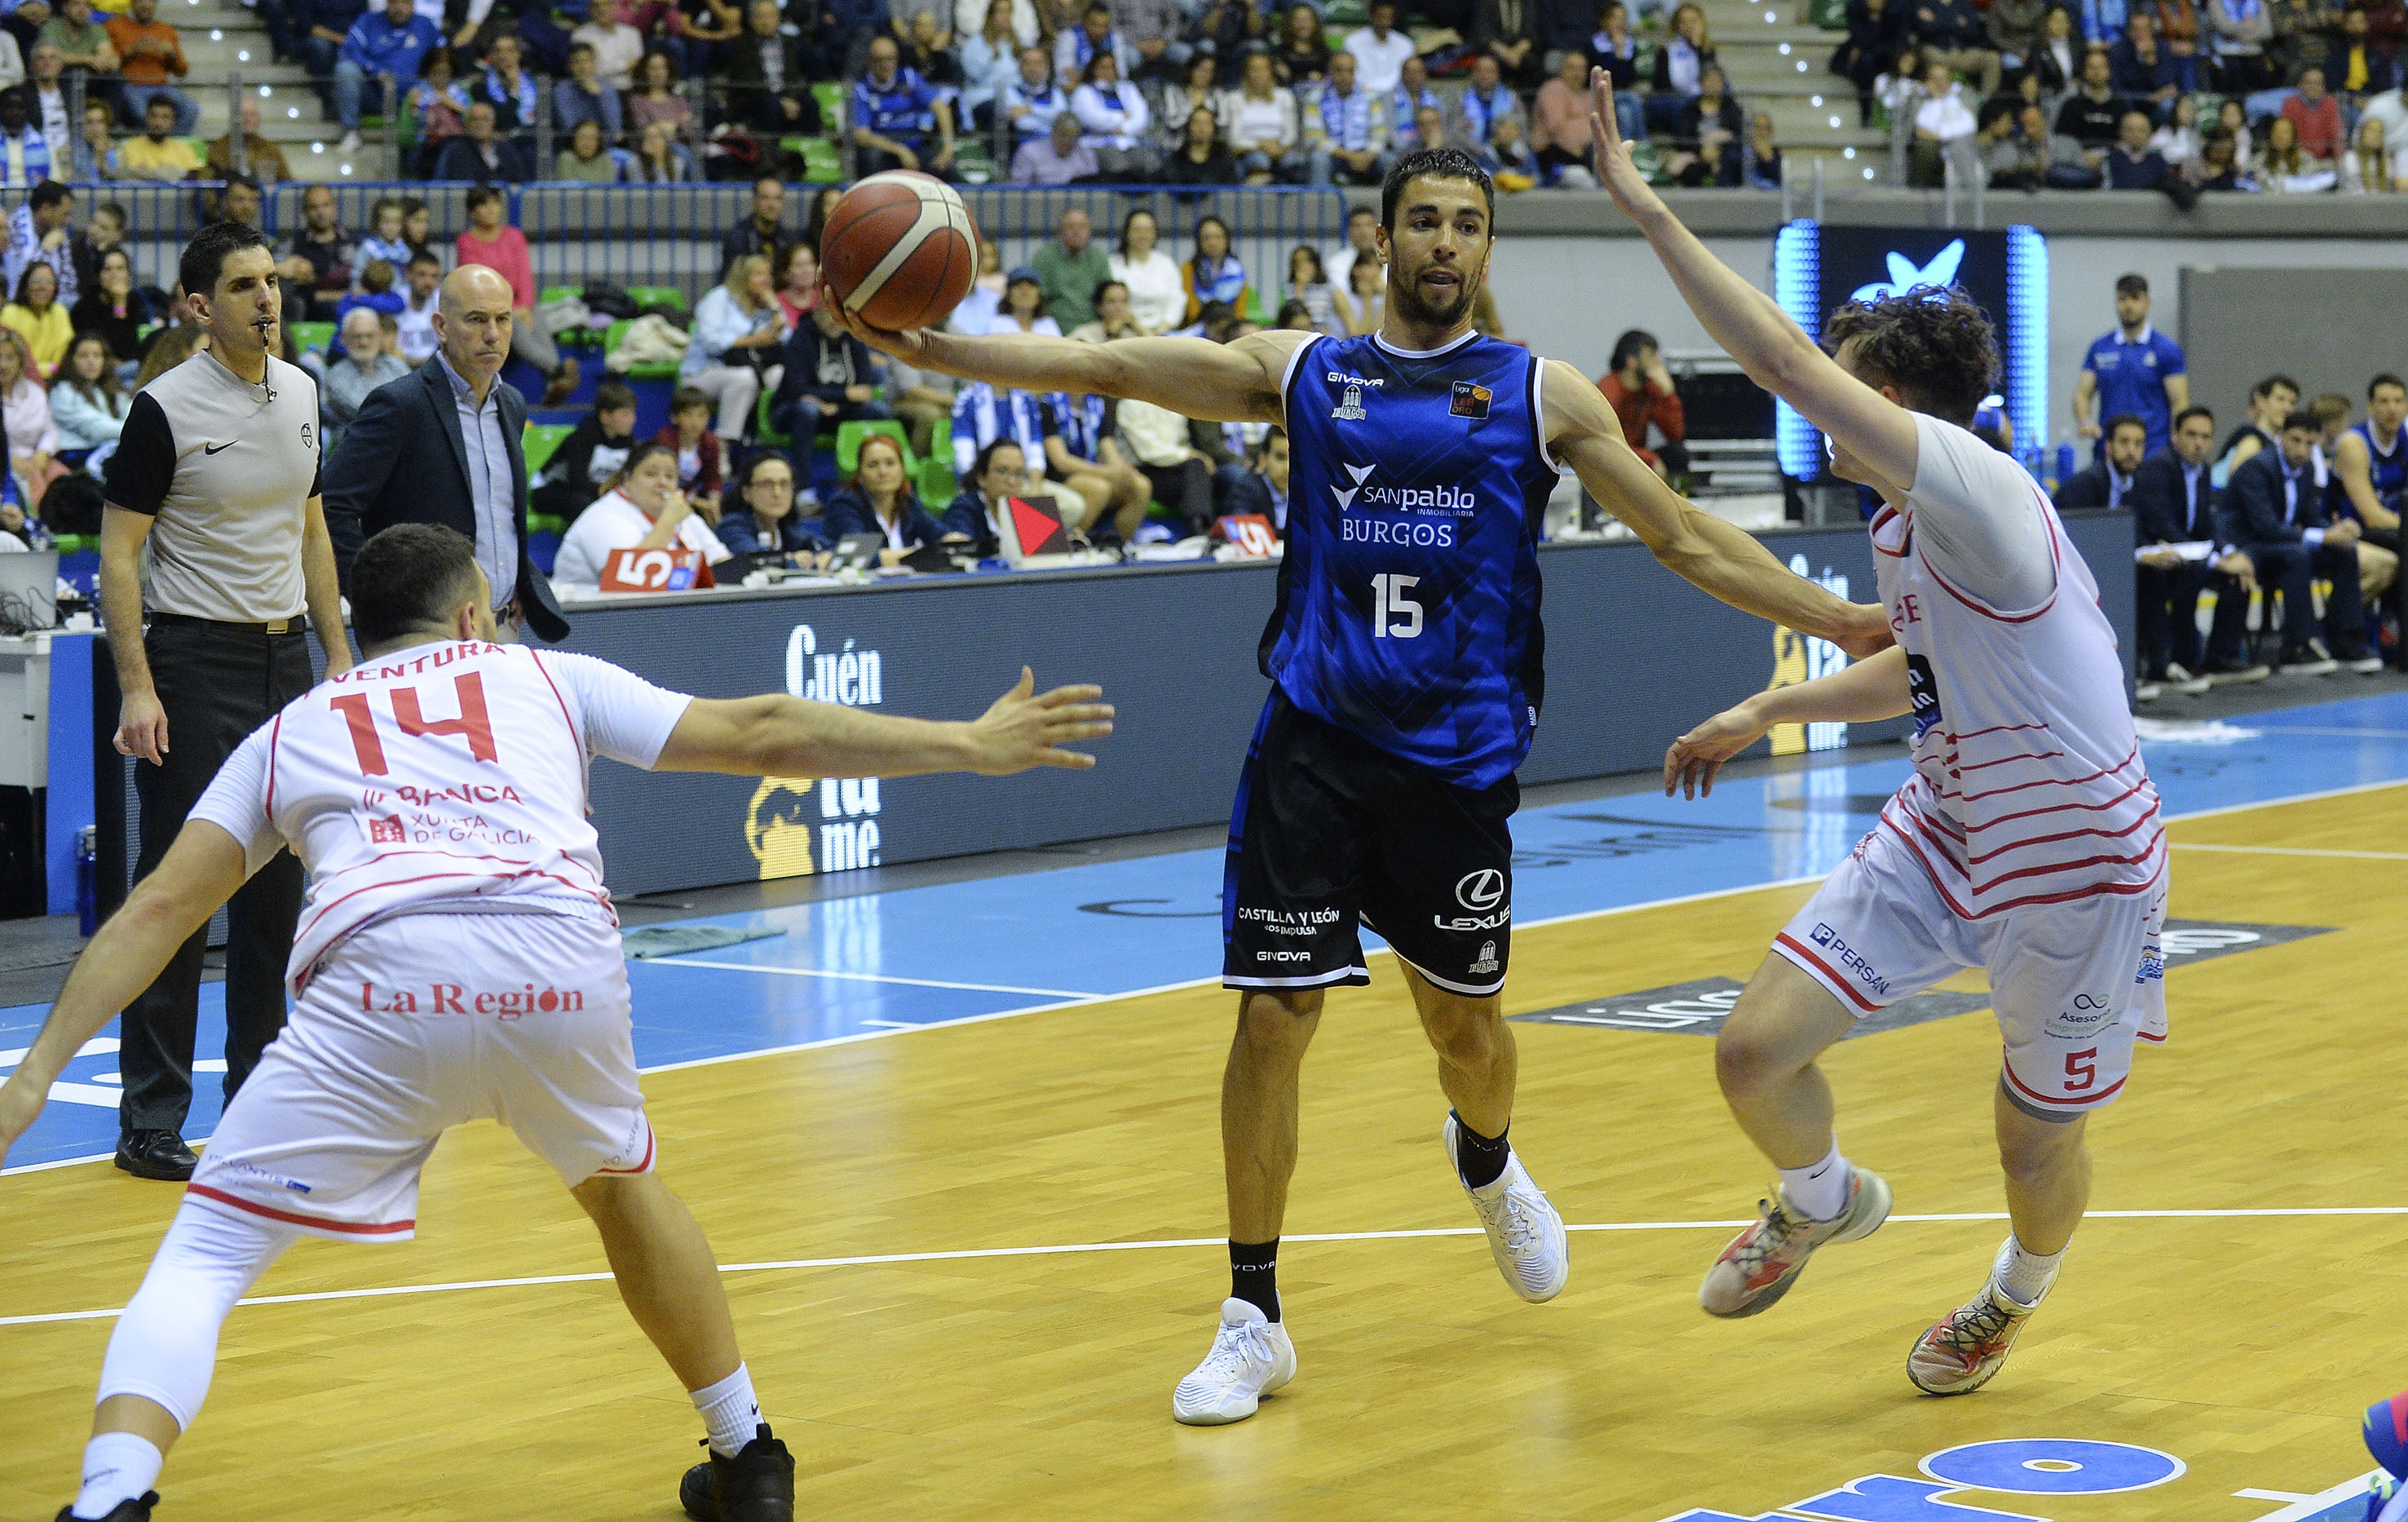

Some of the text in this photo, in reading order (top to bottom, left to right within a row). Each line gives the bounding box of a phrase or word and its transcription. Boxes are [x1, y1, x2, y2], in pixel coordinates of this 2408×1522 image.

[1328, 372, 1384, 387] GIVOVA
[1455, 385, 1469, 393] Liga
[1333, 408, 1366, 419] BURGOS
[1451, 405, 1473, 415] ORO
[1364, 484, 1475, 511] SANpablo
[1417, 508, 1474, 517] INMOBILIARIA
[1342, 519, 1452, 548] BURGOS
[616, 551, 674, 587] 5
[1371, 573, 1424, 639] 15
[331, 642, 507, 684] VENTURA
[785, 623, 882, 706] Cuén
[330, 670, 498, 776] 14
[411, 812, 488, 829] XUTA
[1238, 907, 1340, 927] CASTILLA Y LEÓN
[1434, 905, 1510, 931] LEXUS
[1257, 951, 1311, 962] GIVOVA
[1830, 938, 1890, 995] PERSAN
[362, 981, 583, 1020] La Región
[2064, 1046, 2097, 1091] 5
